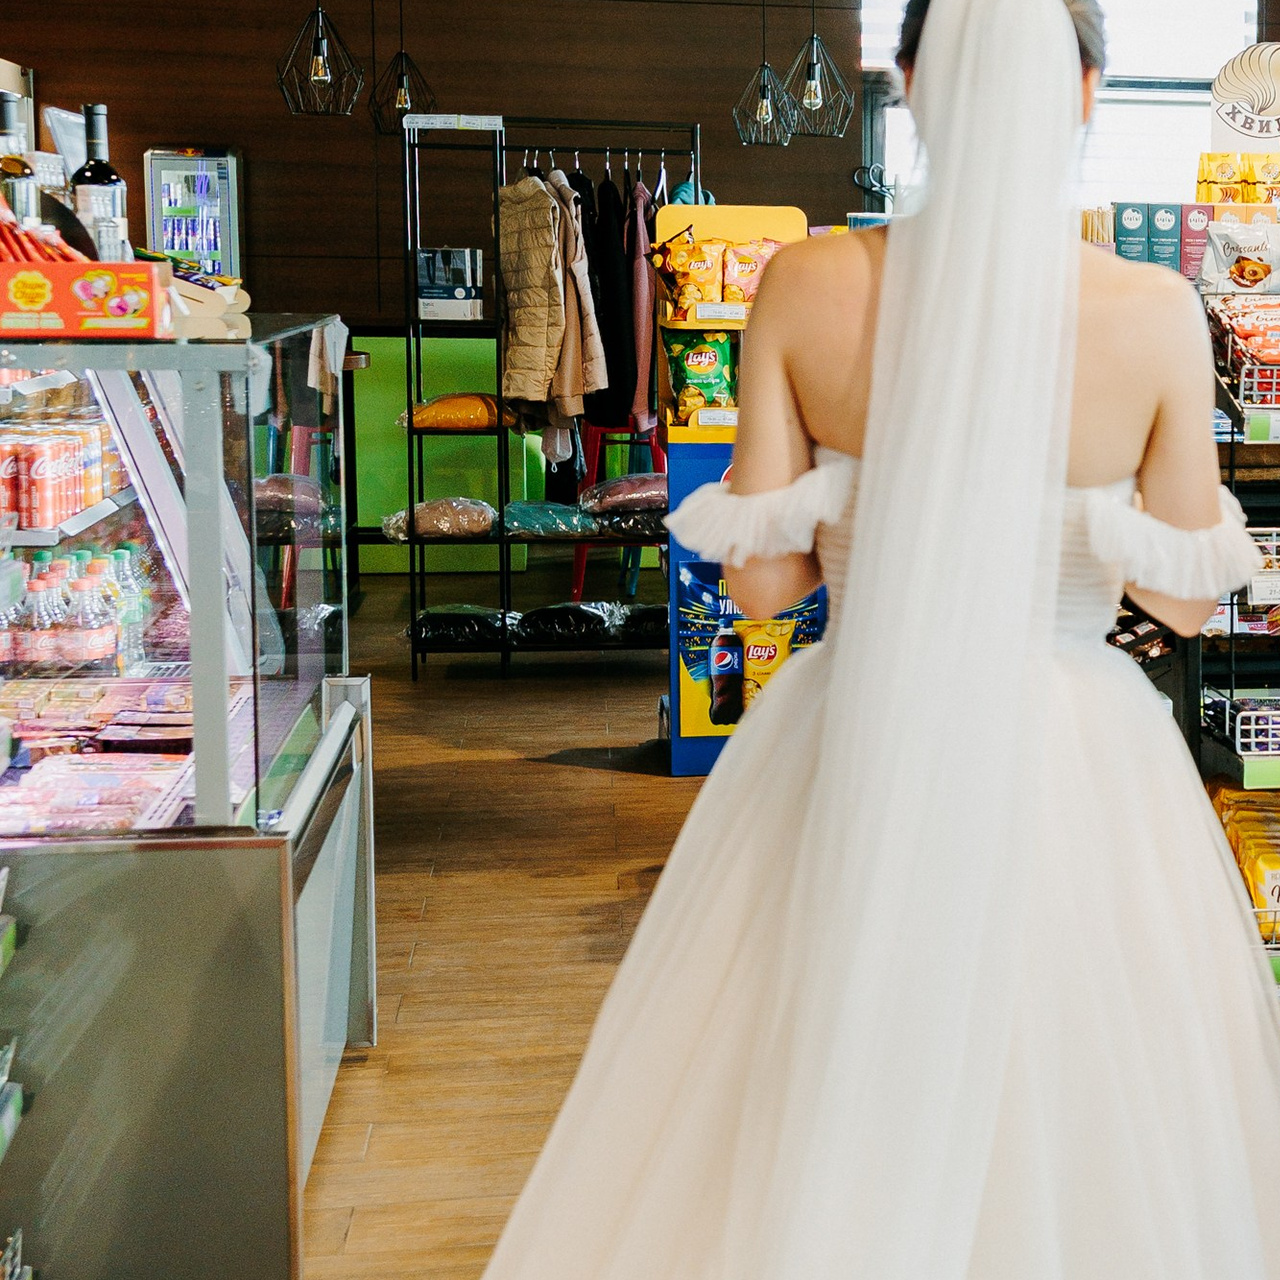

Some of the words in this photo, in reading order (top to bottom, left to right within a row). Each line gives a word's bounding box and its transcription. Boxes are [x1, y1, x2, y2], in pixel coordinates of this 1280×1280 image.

[689, 259, 712, 271] Lay's
[687, 350, 715, 367] Lay's
[747, 644, 776, 661] Lay's
